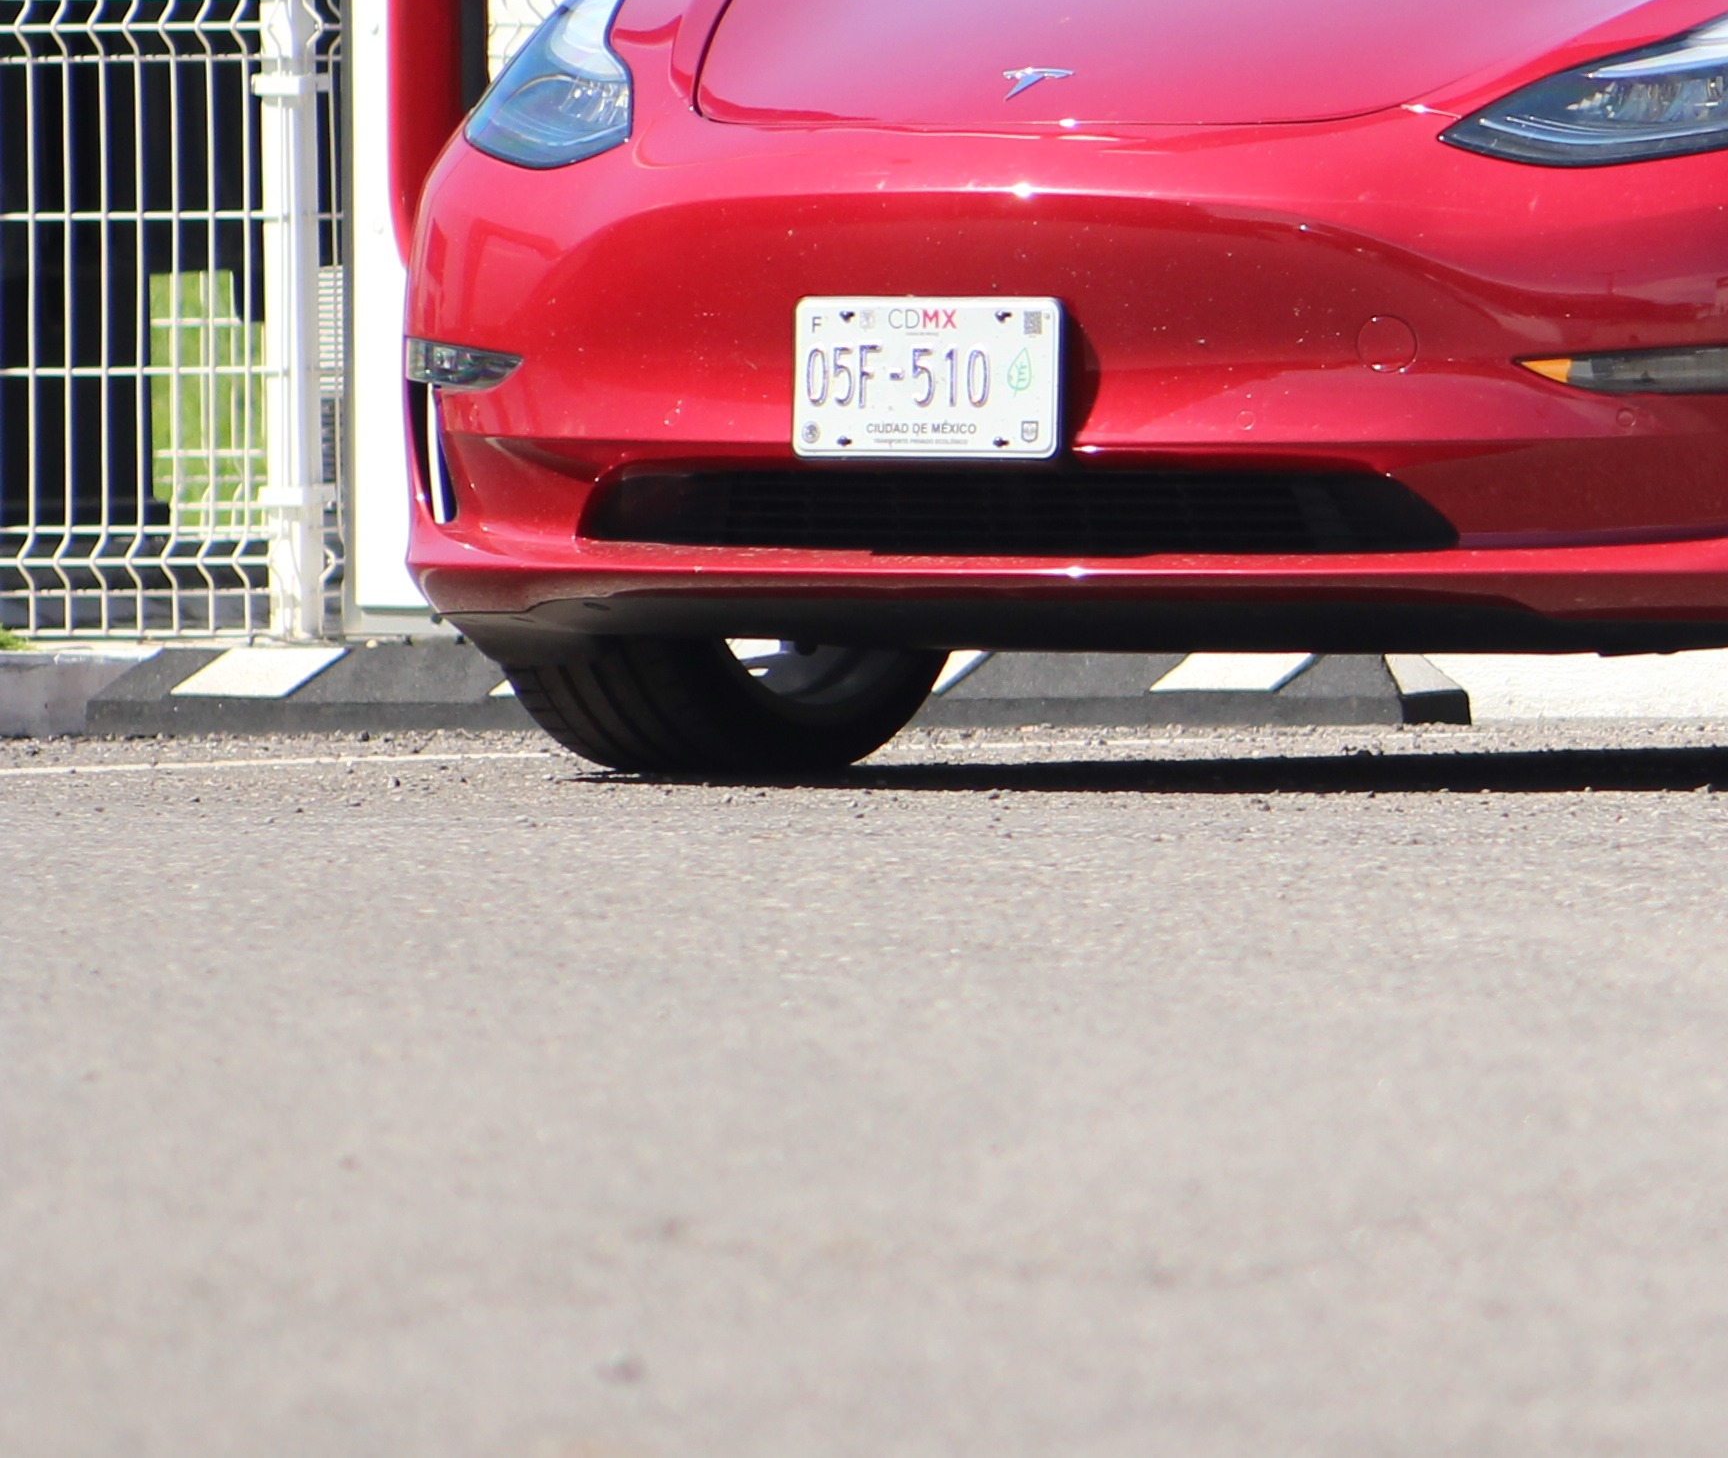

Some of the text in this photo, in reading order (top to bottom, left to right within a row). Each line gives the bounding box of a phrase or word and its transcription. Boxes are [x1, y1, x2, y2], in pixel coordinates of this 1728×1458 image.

[811, 316, 823, 334] F
[887, 308, 958, 330] CDMX
[806, 343, 991, 408] 05F-510
[866, 419, 977, 435] CIUDAD DE MÉXICO
